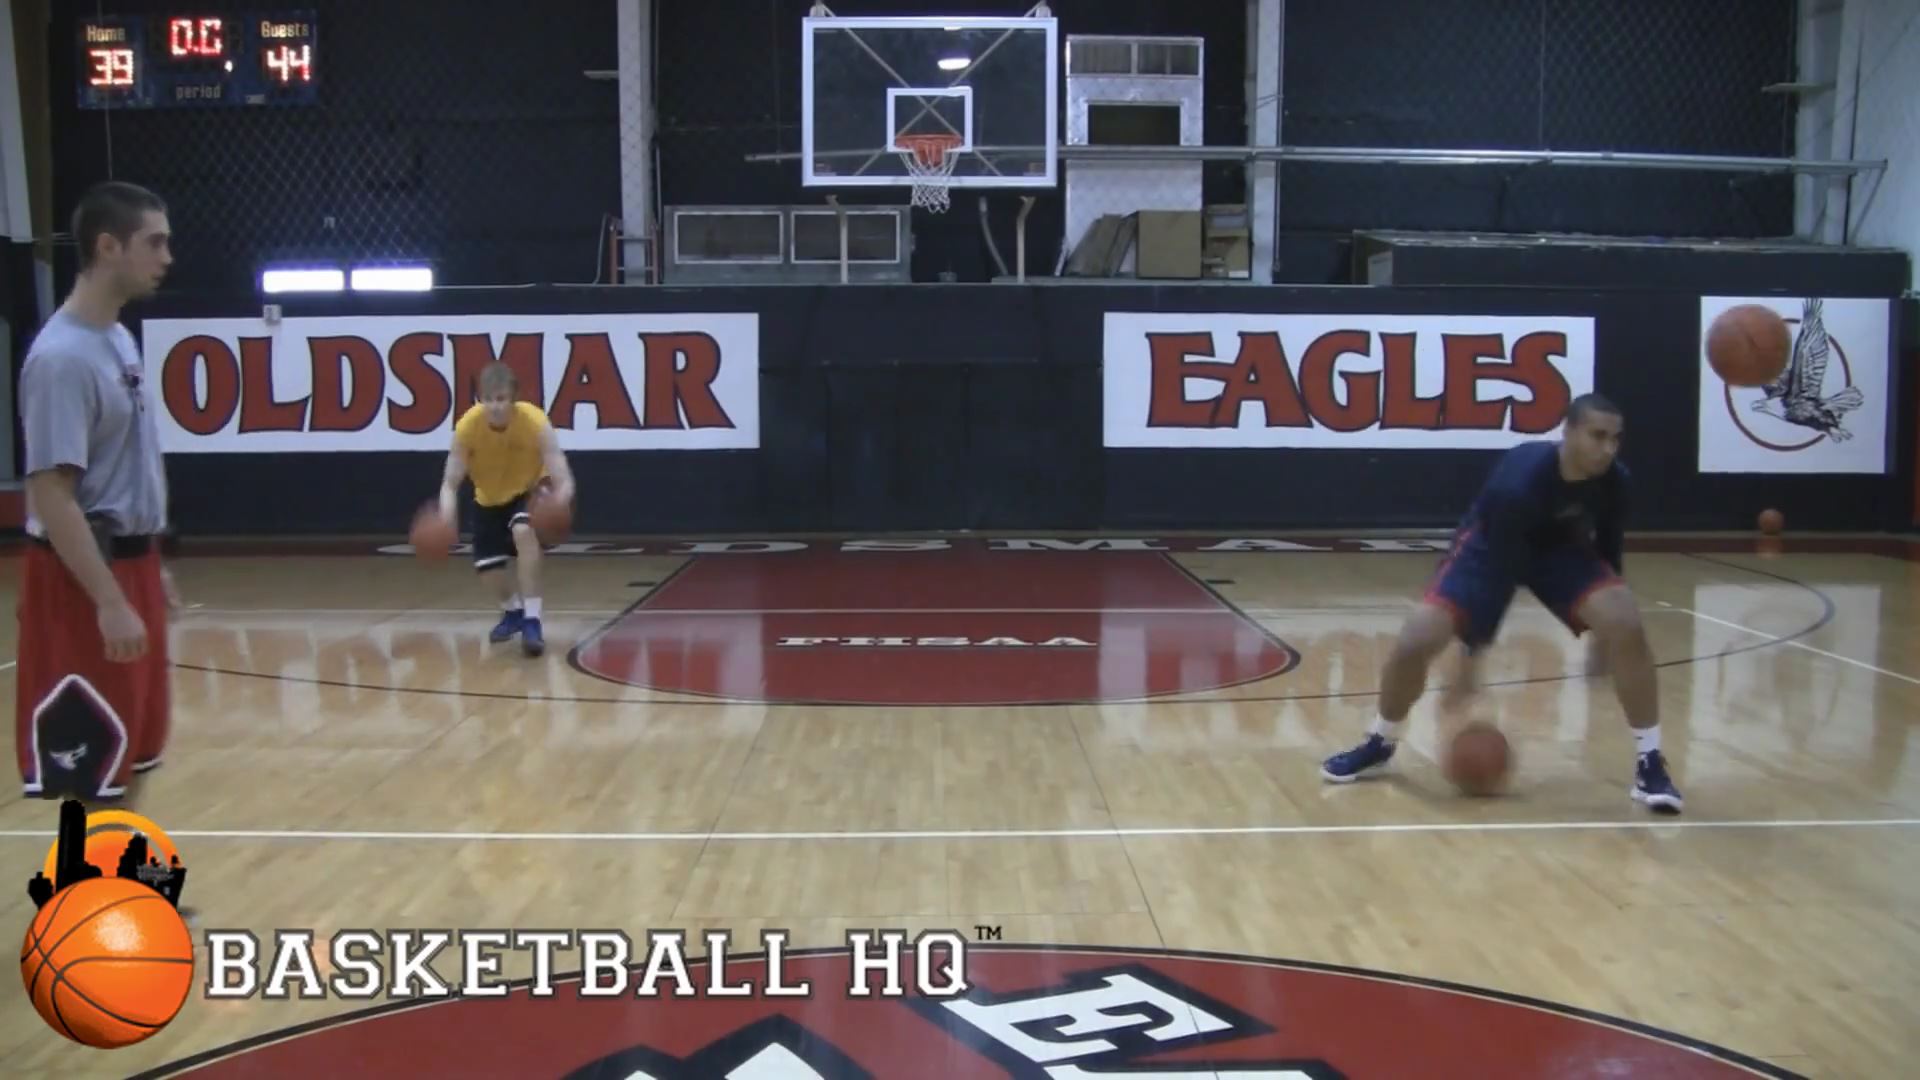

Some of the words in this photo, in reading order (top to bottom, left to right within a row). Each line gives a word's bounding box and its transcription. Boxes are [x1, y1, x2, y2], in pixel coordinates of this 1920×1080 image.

[87, 24, 126, 42] Home
[260, 20, 310, 38] Guests
[90, 49, 134, 85] 39
[266, 45, 311, 82] 44
[175, 84, 221, 99] period
[161, 331, 737, 435] OLDSMAR
[1145, 329, 1572, 433] EAGLES
[776, 636, 1097, 646] FHSAA
